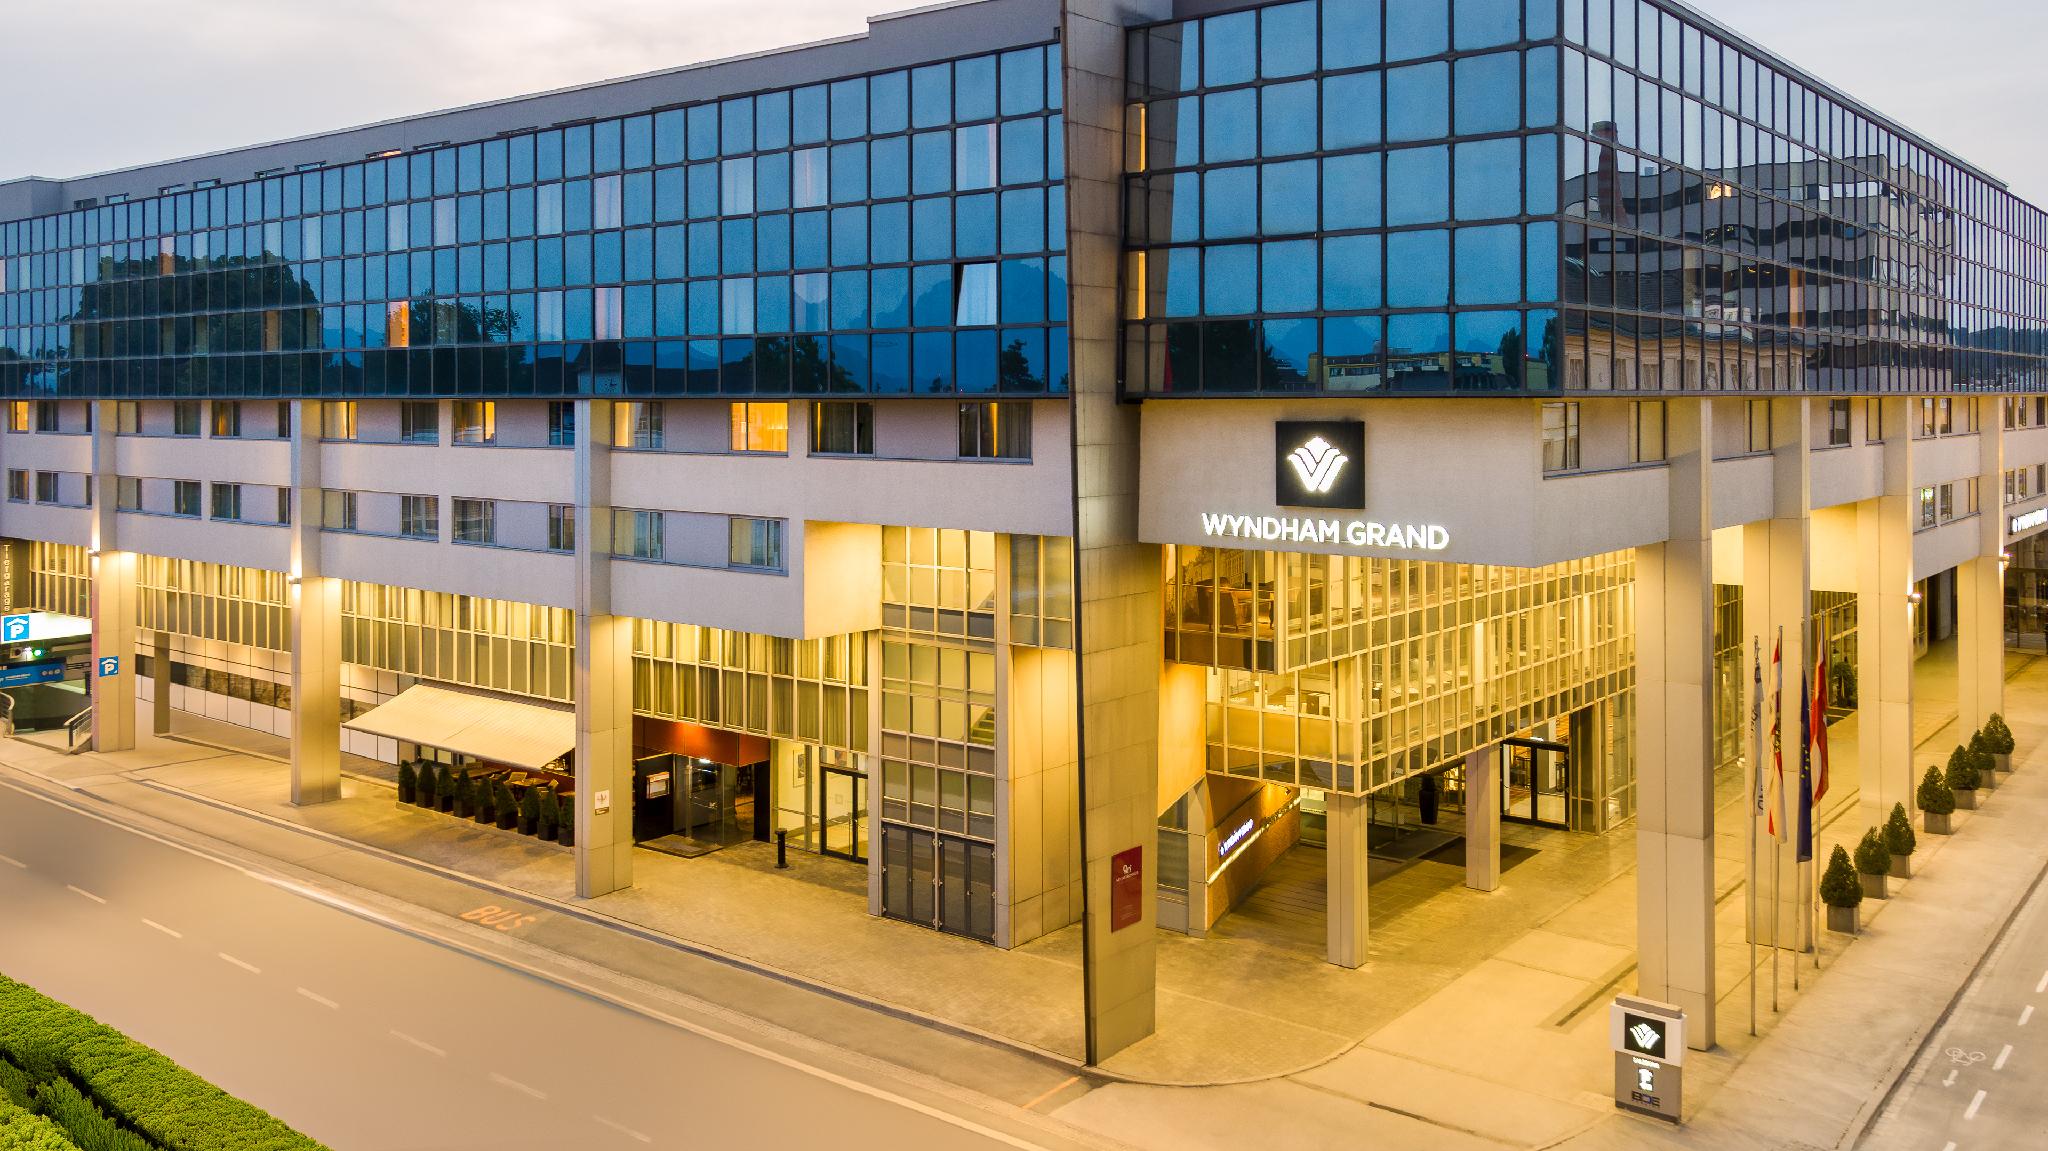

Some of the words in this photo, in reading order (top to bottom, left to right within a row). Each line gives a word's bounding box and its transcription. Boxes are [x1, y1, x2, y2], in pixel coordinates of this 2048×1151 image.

[1201, 512, 1340, 543] WYNDHAM
[1346, 523, 1449, 550] GRAND
[10, 625, 25, 639] P
[104, 663, 115, 675] P
[460, 905, 536, 931] BUS
